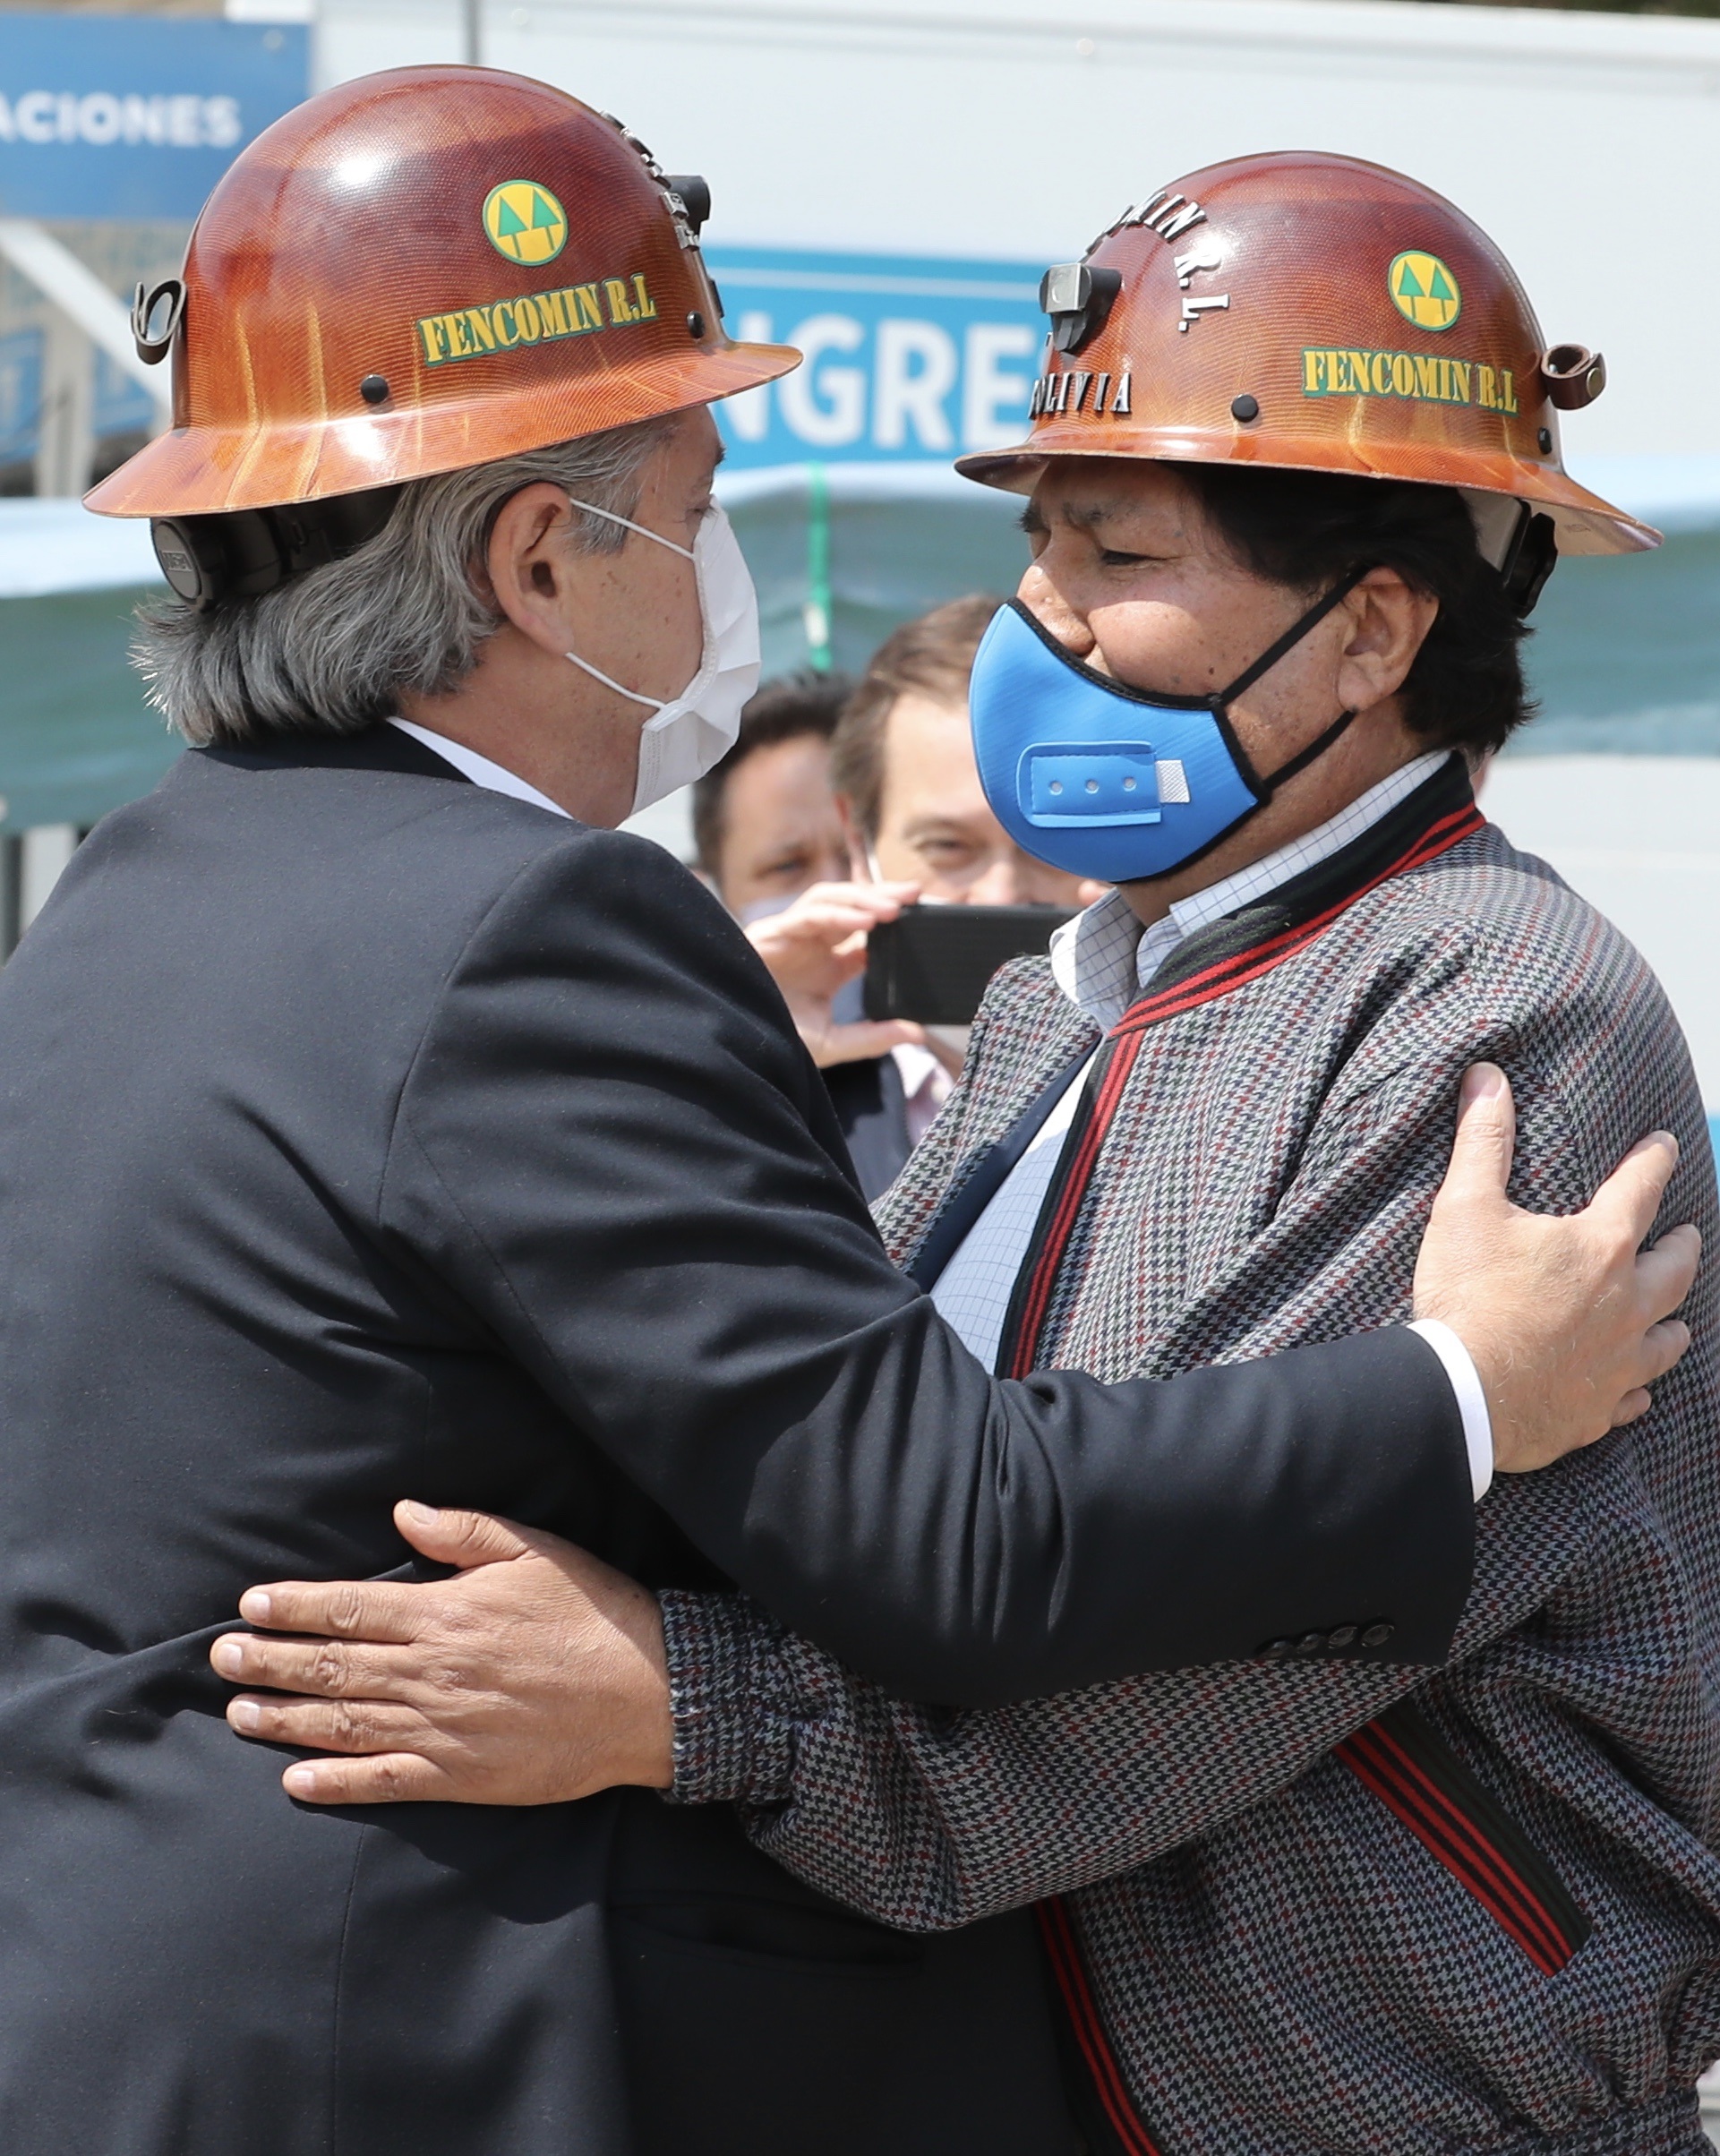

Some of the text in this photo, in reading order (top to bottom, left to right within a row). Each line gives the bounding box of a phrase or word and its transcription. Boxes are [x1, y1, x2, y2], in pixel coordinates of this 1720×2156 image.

[418, 275, 656, 363] FENCOMIN R.L
[1304, 350, 1519, 414] FENCOMIN R.L
